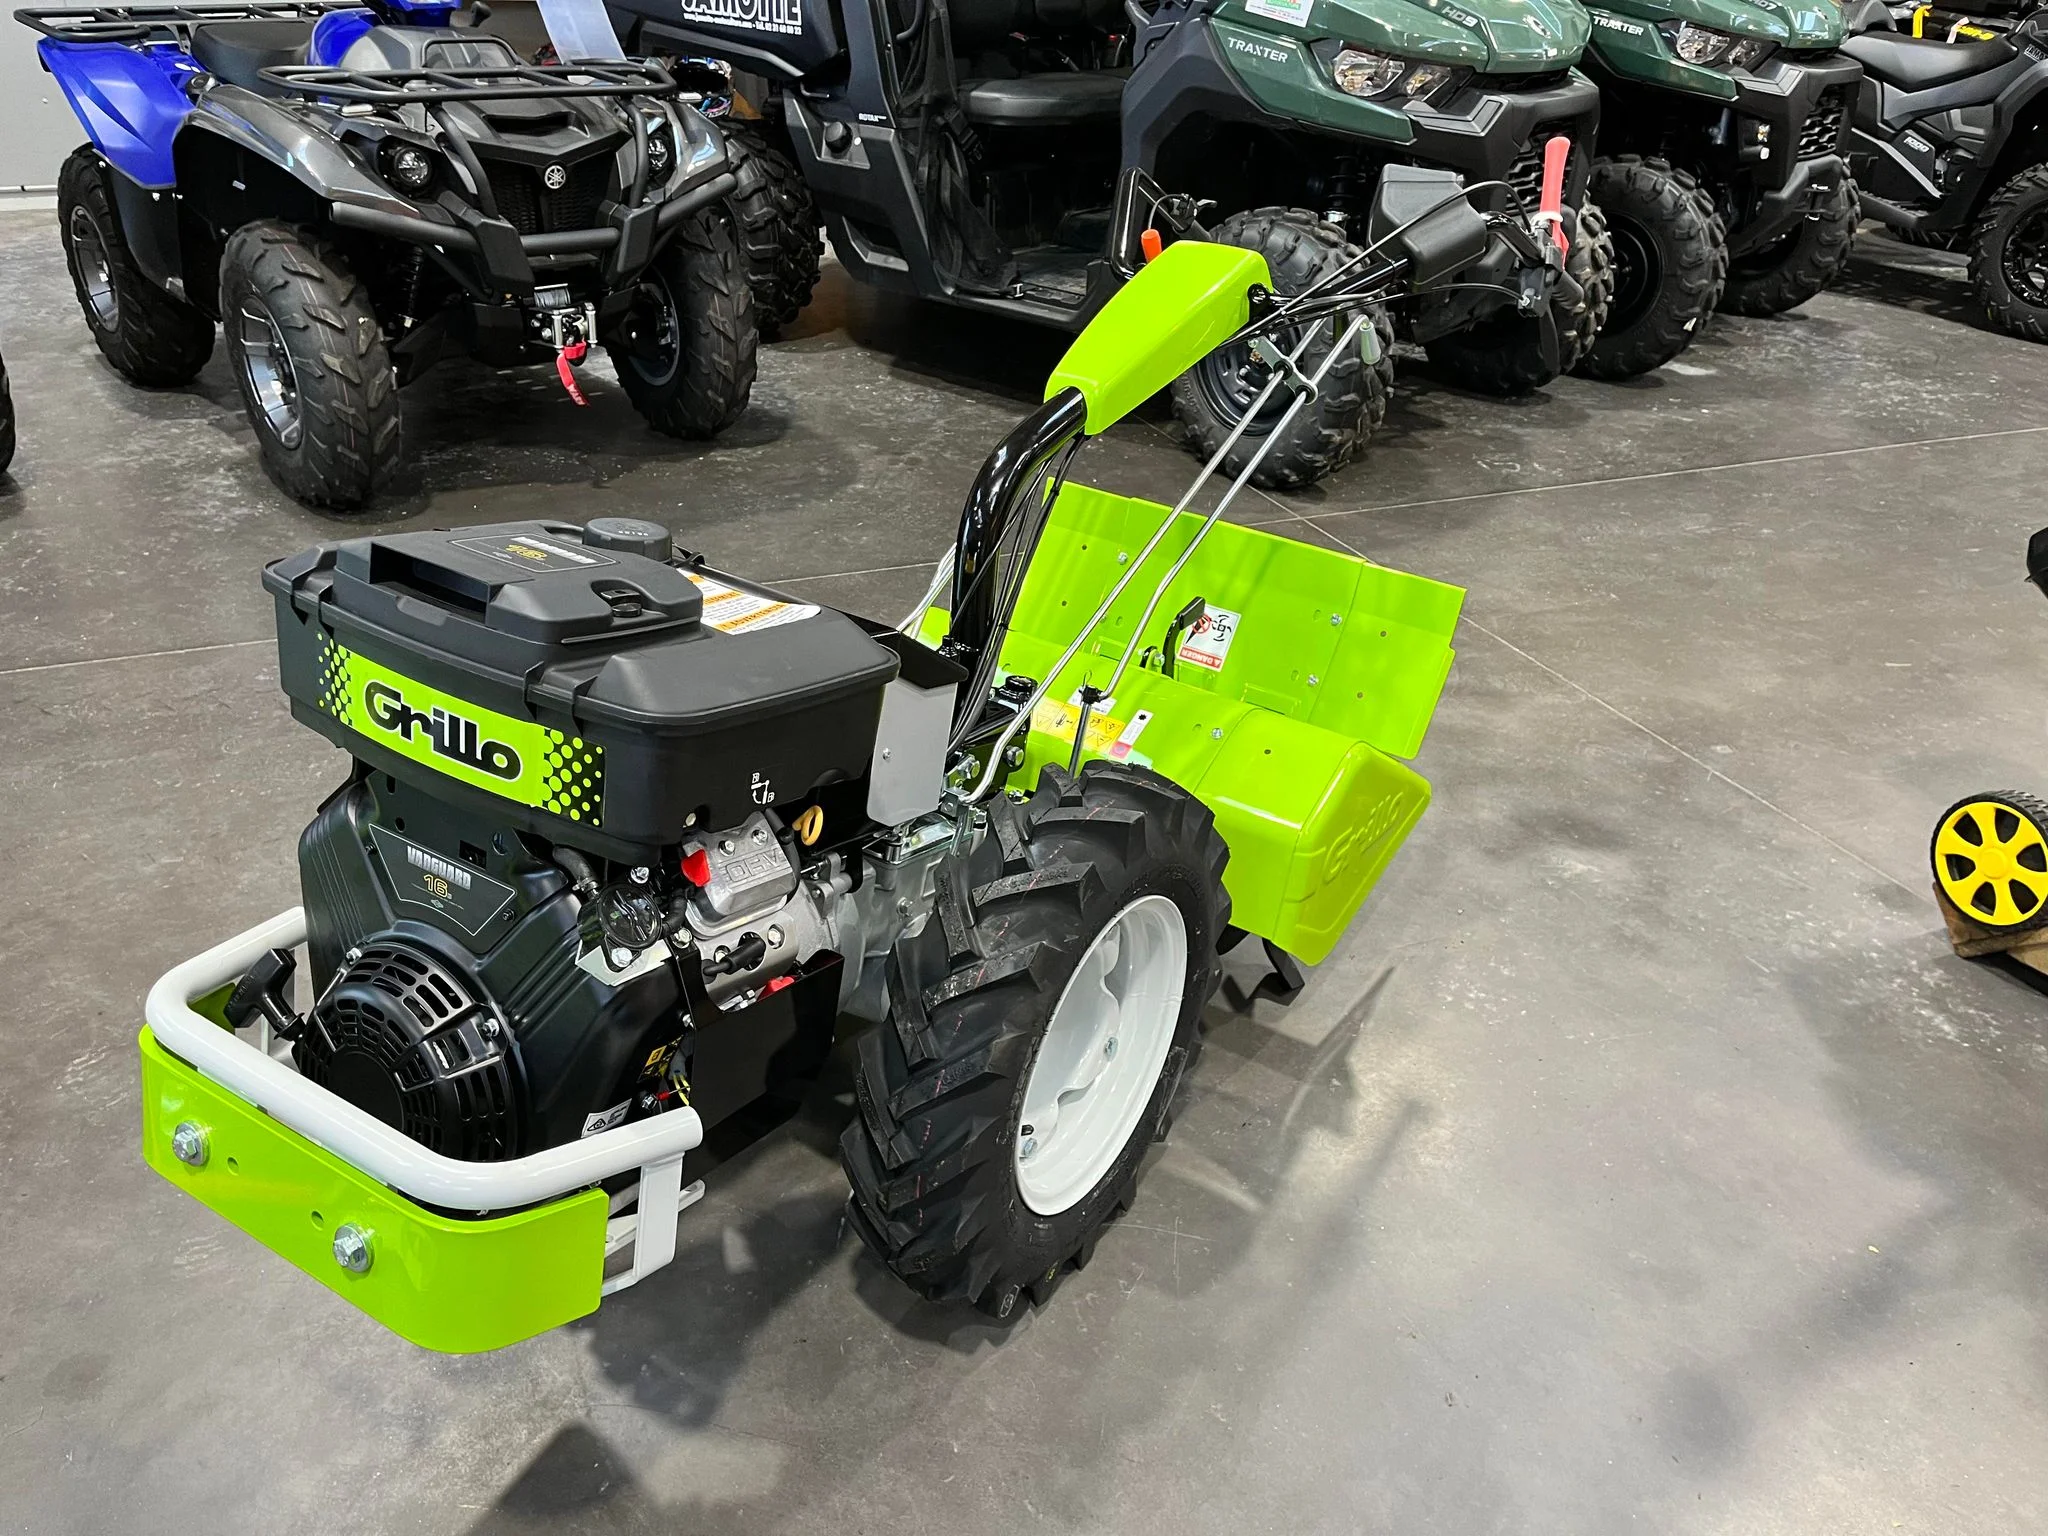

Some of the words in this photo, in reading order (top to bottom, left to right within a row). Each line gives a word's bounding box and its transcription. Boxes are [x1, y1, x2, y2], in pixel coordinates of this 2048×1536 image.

[1441, 6, 1478, 27] HD9
[1593, 16, 1643, 36] TRAXTER
[1228, 37, 1288, 63] TRAXTER
[364, 679, 523, 783] Grillo
[407, 845, 472, 890] VANGUARD
[424, 874, 448, 898] 16
